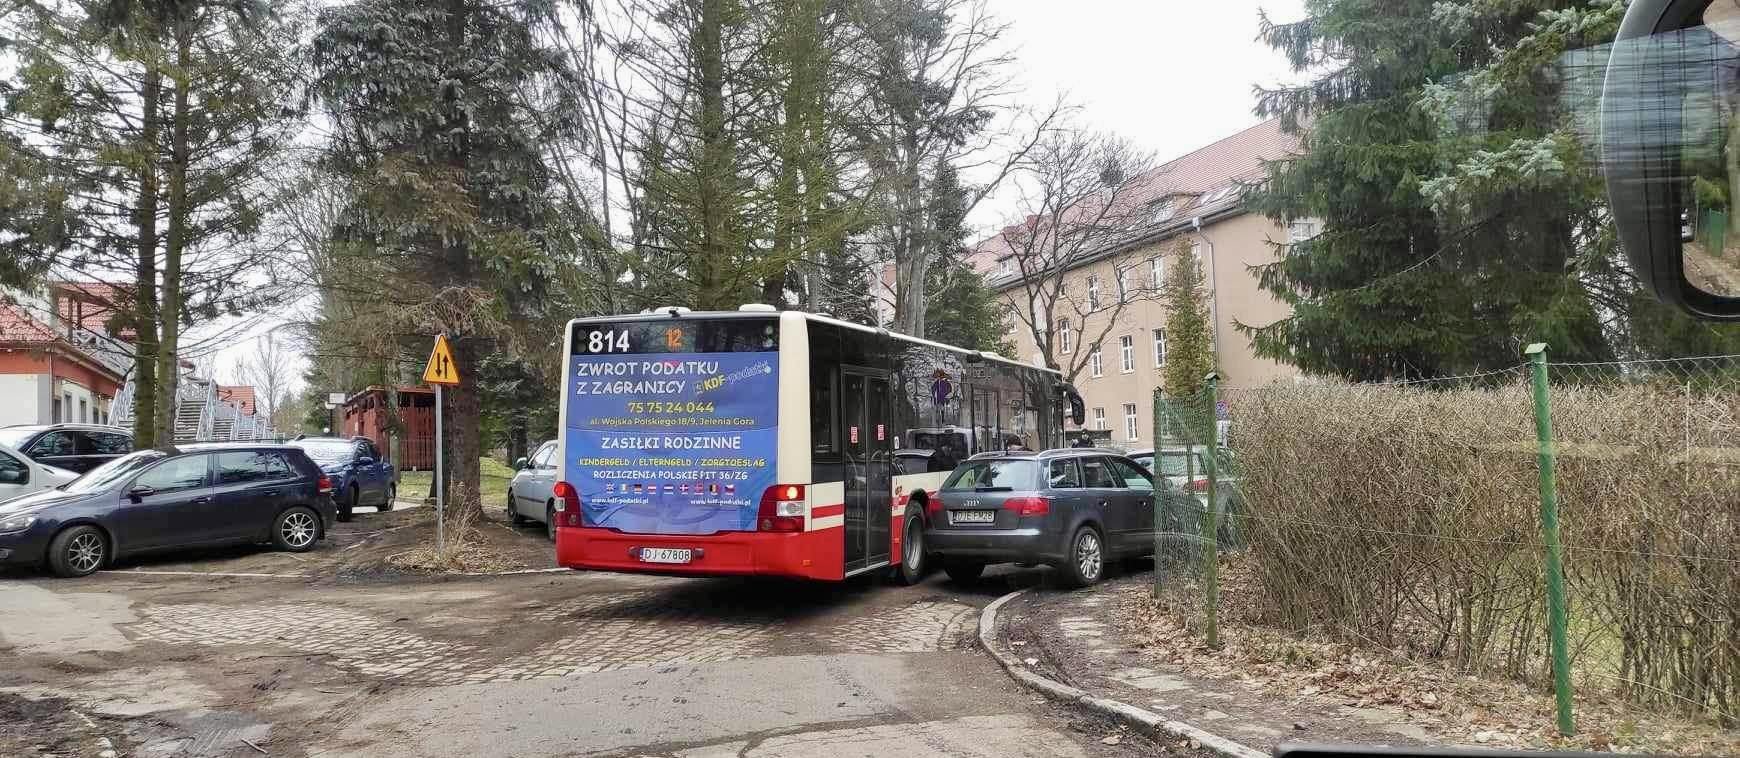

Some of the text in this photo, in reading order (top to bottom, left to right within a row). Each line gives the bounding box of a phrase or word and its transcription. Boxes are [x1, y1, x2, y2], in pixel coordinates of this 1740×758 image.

[588, 330, 630, 353] 814
[665, 328, 683, 348] 12
[577, 361, 719, 377] ZWROT PODATKU
[576, 380, 686, 395] Z ZAGRANICY
[628, 401, 715, 414] 75 75 24 044
[601, 416, 632, 427] Wojska
[634, 417, 677, 427] Polskiego
[699, 416, 731, 425] Jelenia
[601, 436, 741, 450] ZASIŁKI RODZINNE
[580, 458, 630, 467] KINDERGELD
[638, 458, 692, 467] ELTERNGELD
[700, 458, 765, 467] ZORGTOESLAG
[593, 470, 748, 480] ROZLICZENIA POLSKIE PIT 36/ZG
[644, 549, 690, 561] DJ 67808
